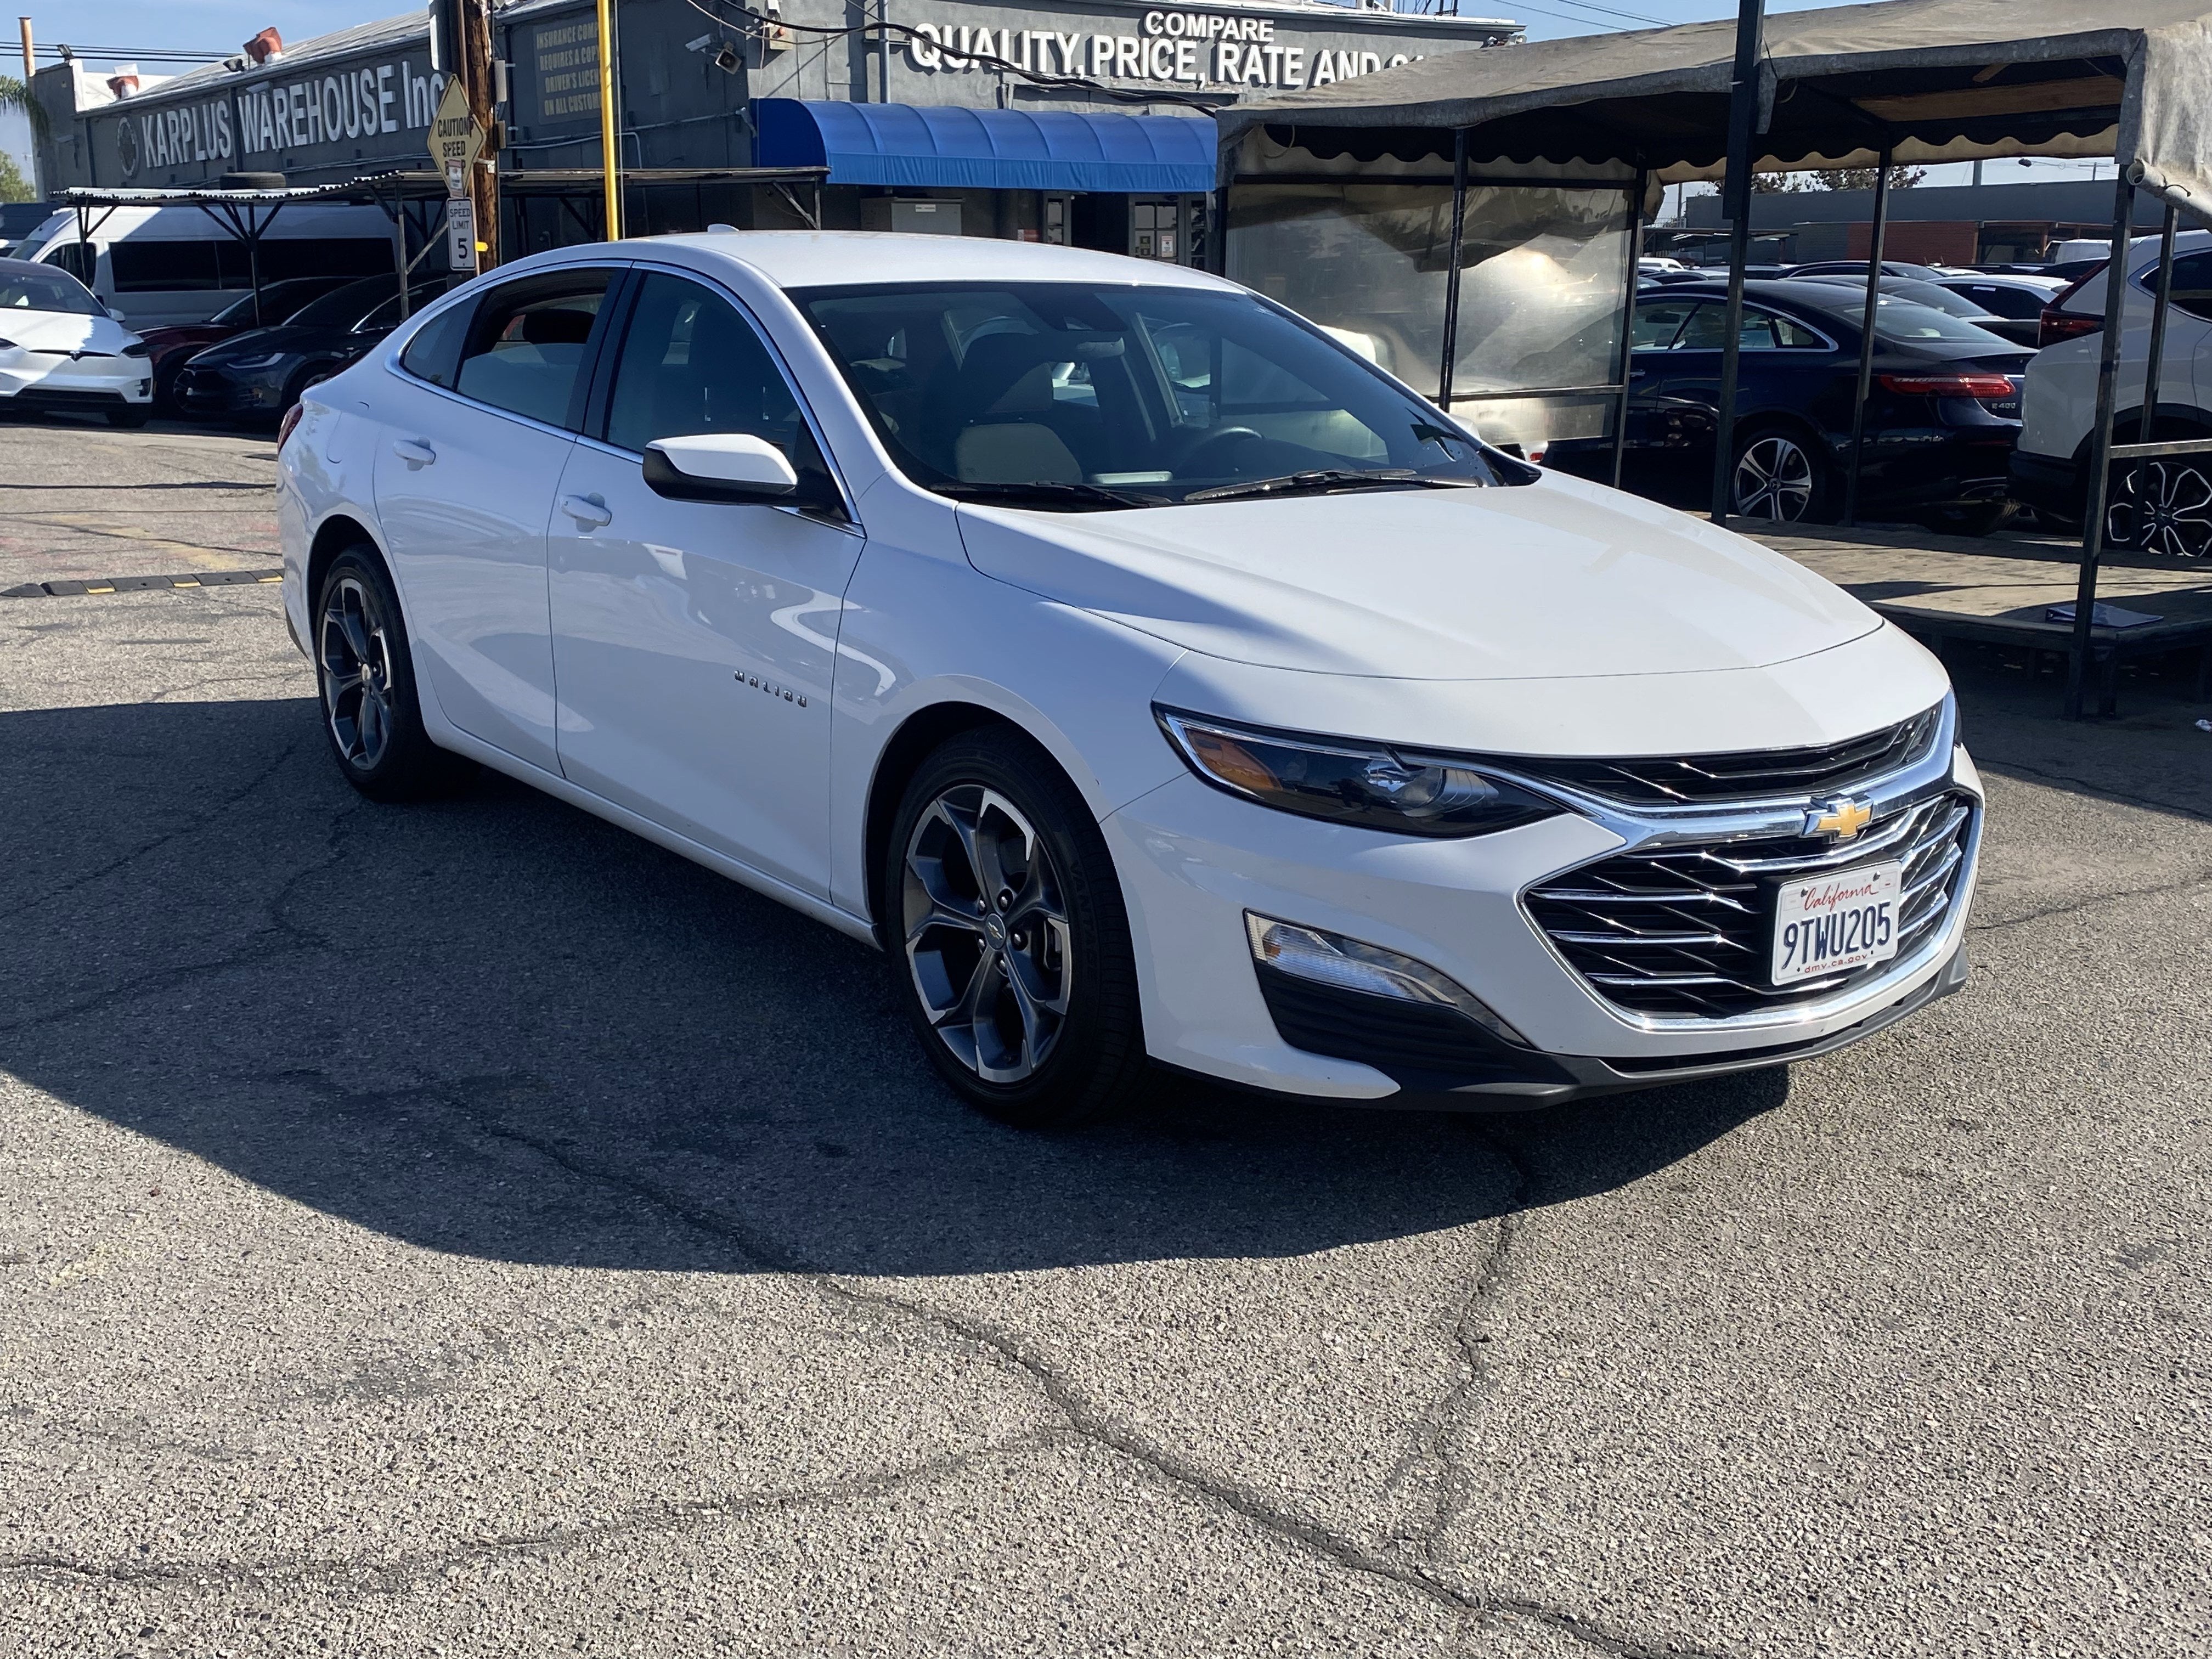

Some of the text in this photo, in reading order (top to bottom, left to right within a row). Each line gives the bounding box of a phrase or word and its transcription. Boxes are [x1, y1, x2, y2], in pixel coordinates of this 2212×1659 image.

[537, 26, 576, 50] INSURANCE
[1145, 11, 1274, 42] COMPARE
[539, 49, 573, 71] REQUIRES
[574, 48, 580, 65] A
[911, 22, 1381, 89] QUALITY, PRICE, RATE AND
[545, 68, 599, 94] DRIVER'S LICEN
[141, 100, 232, 168] KARPLUS
[237, 64, 399, 154] WAREHOUSE
[544, 92, 601, 116] ON ALL CUSTOM
[438, 117, 470, 138] CAUTION
[443, 140, 466, 157] SPEED
[450, 208, 470, 218] SPEED
[452, 221, 470, 230] LIMIT
[458, 238, 467, 259] 5
[733, 669, 807, 708] MALIBU
[1804, 882, 1879, 912] California
[1781, 899, 1892, 970] 9TWU205
[1804, 953, 1868, 973] dmv.ca.gov
